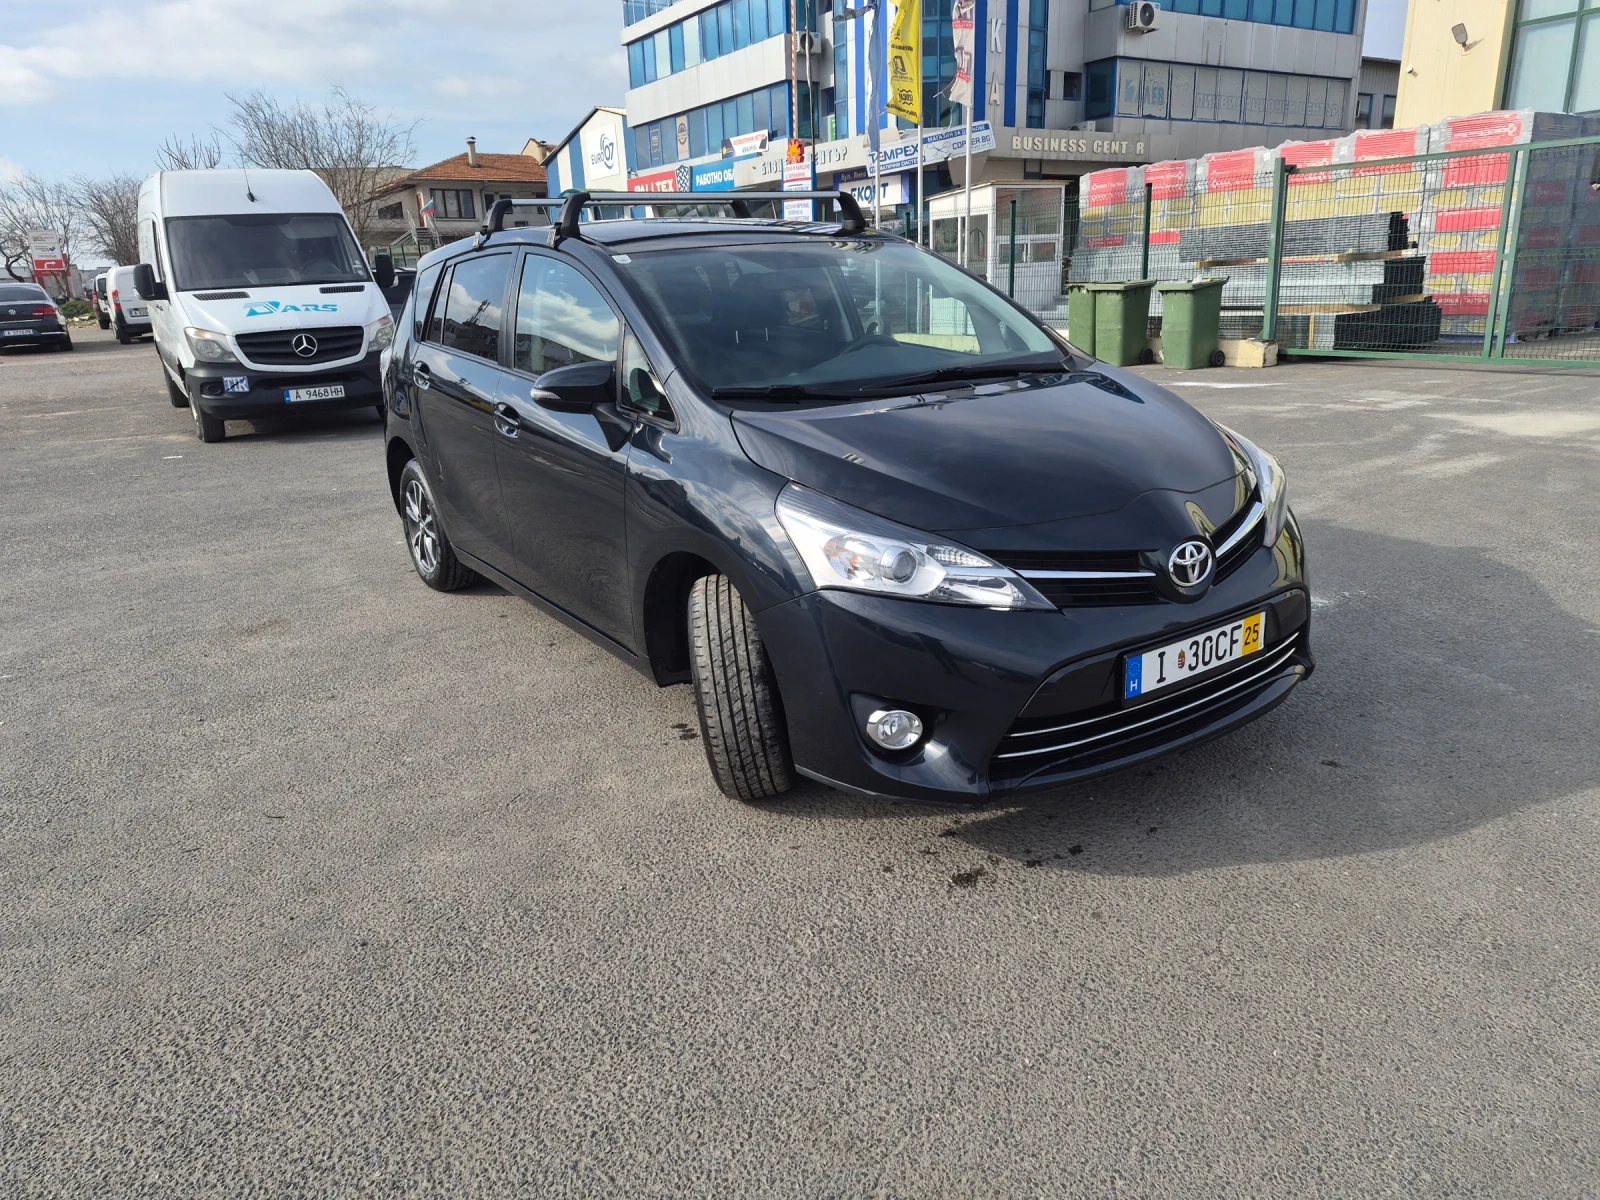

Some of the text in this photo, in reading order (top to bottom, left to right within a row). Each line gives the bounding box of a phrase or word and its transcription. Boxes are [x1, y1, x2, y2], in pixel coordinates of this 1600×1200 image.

[952, 135, 991, 149] COPER.BG
[1012, 136, 1086, 153] BUSINESS
[695, 171, 722, 186] РАБОТНО
[295, 390, 301, 399] A
[1188, 624, 1242, 672] 30CF
[1244, 623, 1260, 646] 25
[1130, 679, 1138, 692] H
